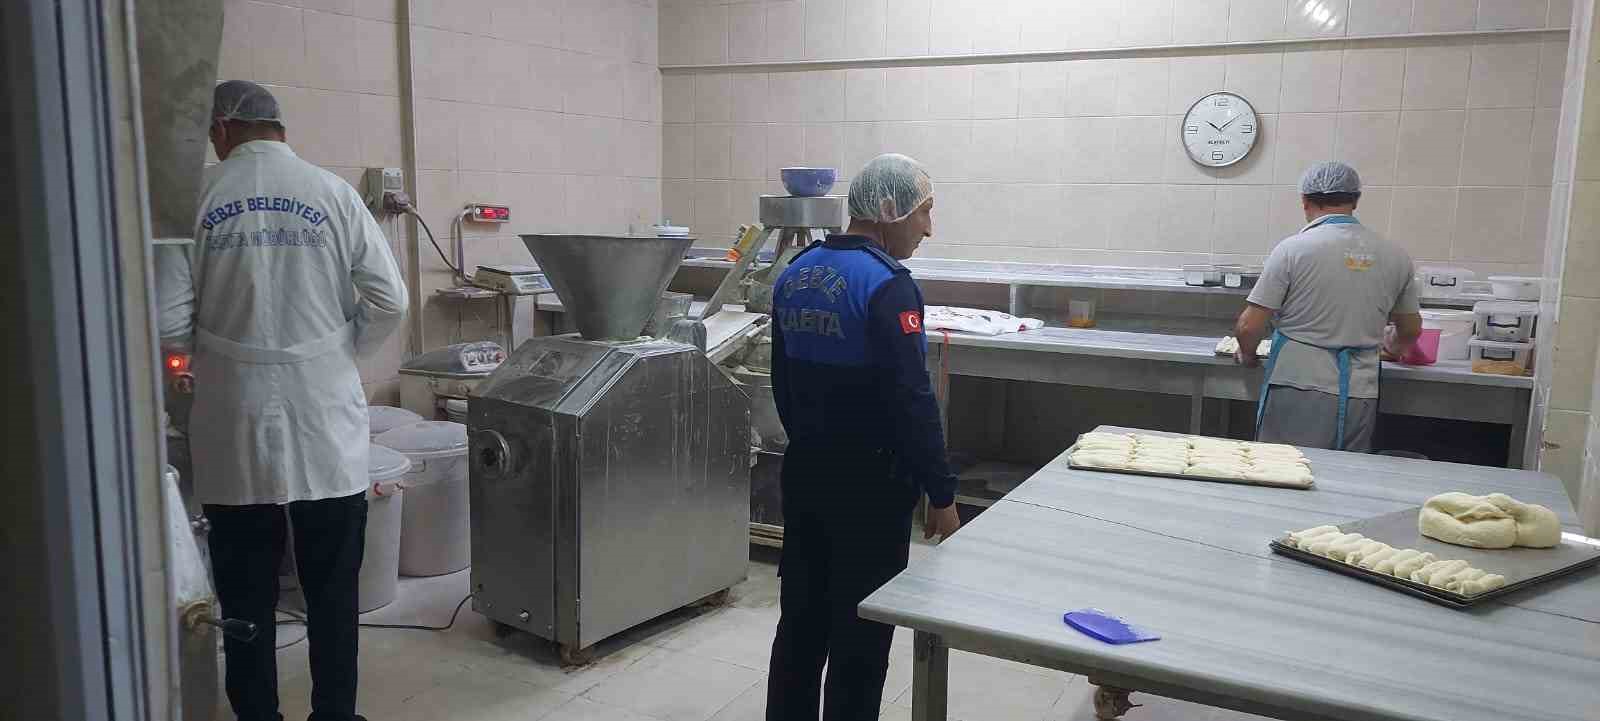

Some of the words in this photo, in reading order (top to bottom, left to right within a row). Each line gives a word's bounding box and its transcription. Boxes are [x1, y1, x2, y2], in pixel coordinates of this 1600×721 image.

[1214, 98, 1230, 107] 12
[1239, 124, 1253, 134] 3
[1211, 150, 1224, 161] 6
[201, 201, 245, 231] GEBZE
[783, 265, 847, 303] GEBZE
